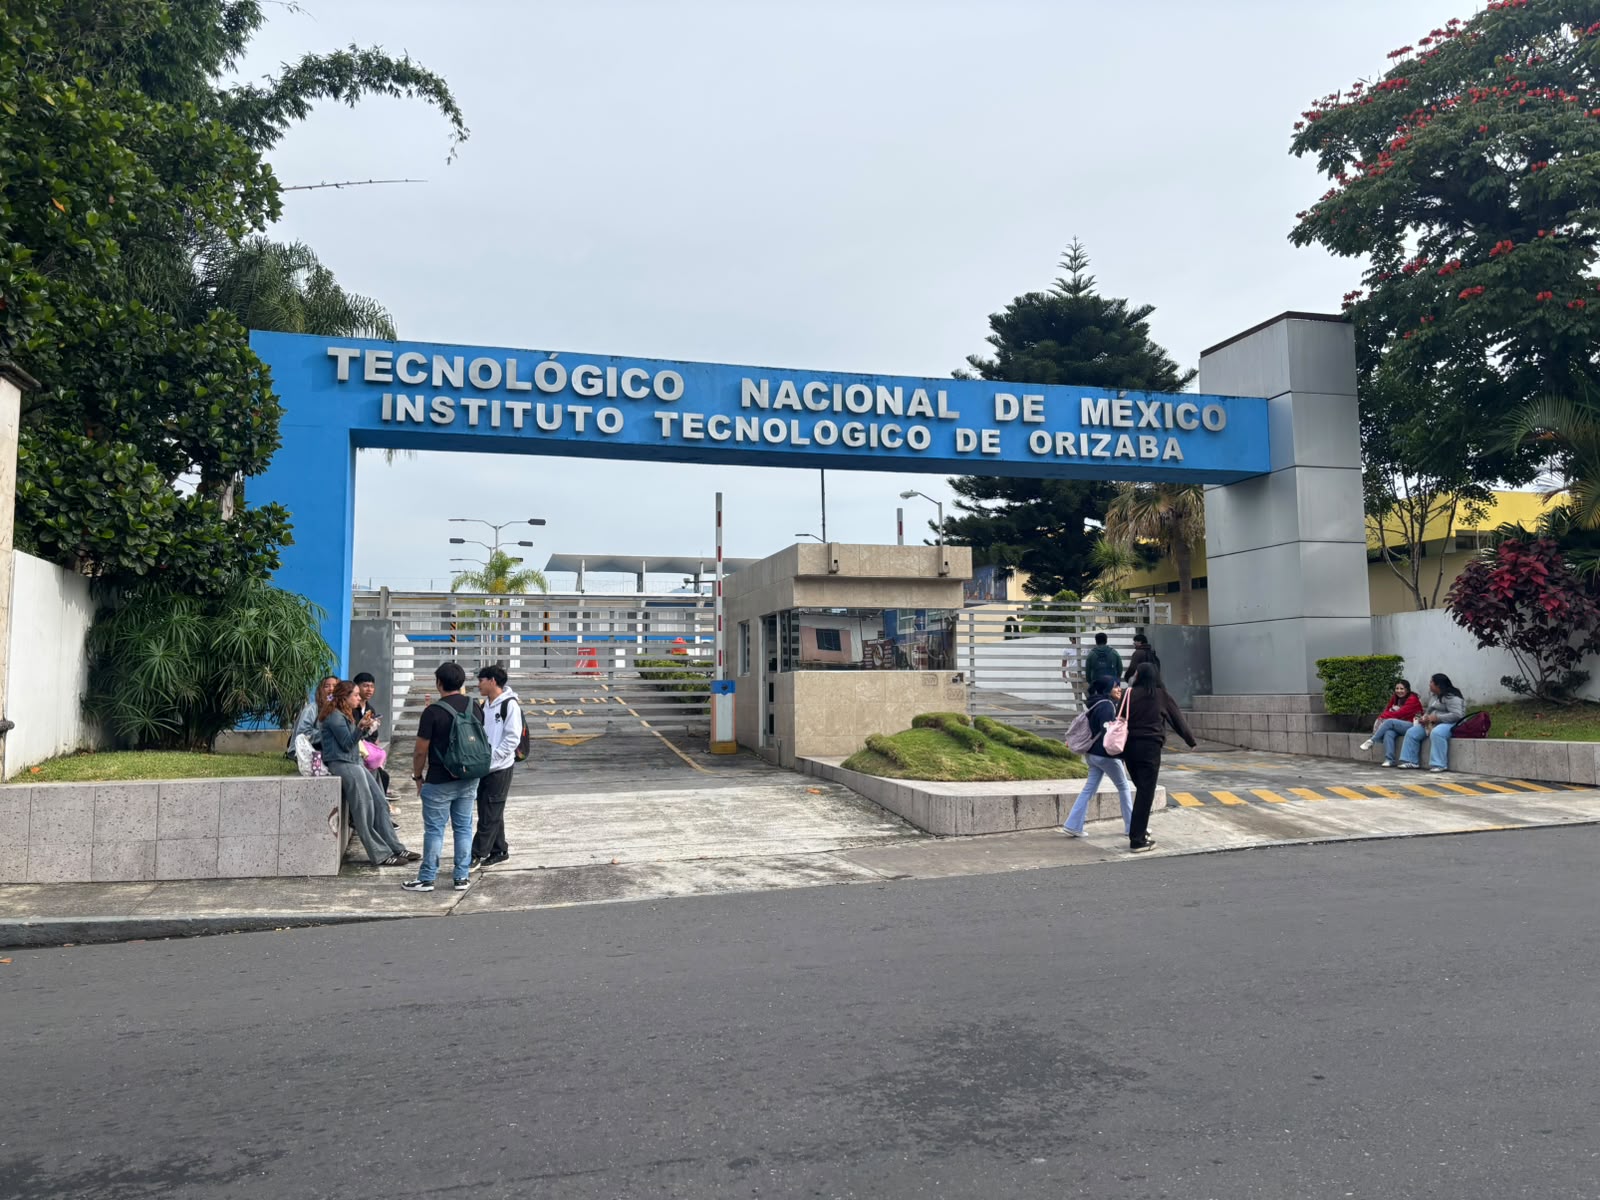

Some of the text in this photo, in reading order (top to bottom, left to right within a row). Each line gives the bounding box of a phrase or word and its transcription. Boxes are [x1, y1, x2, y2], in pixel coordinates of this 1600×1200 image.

[327, 346, 1227, 432] TECNOLÓGICO NACIONAL DE MÉXICO
[382, 393, 1184, 460] INSTITUTO TECNOLOGICO DE ORIZABA
